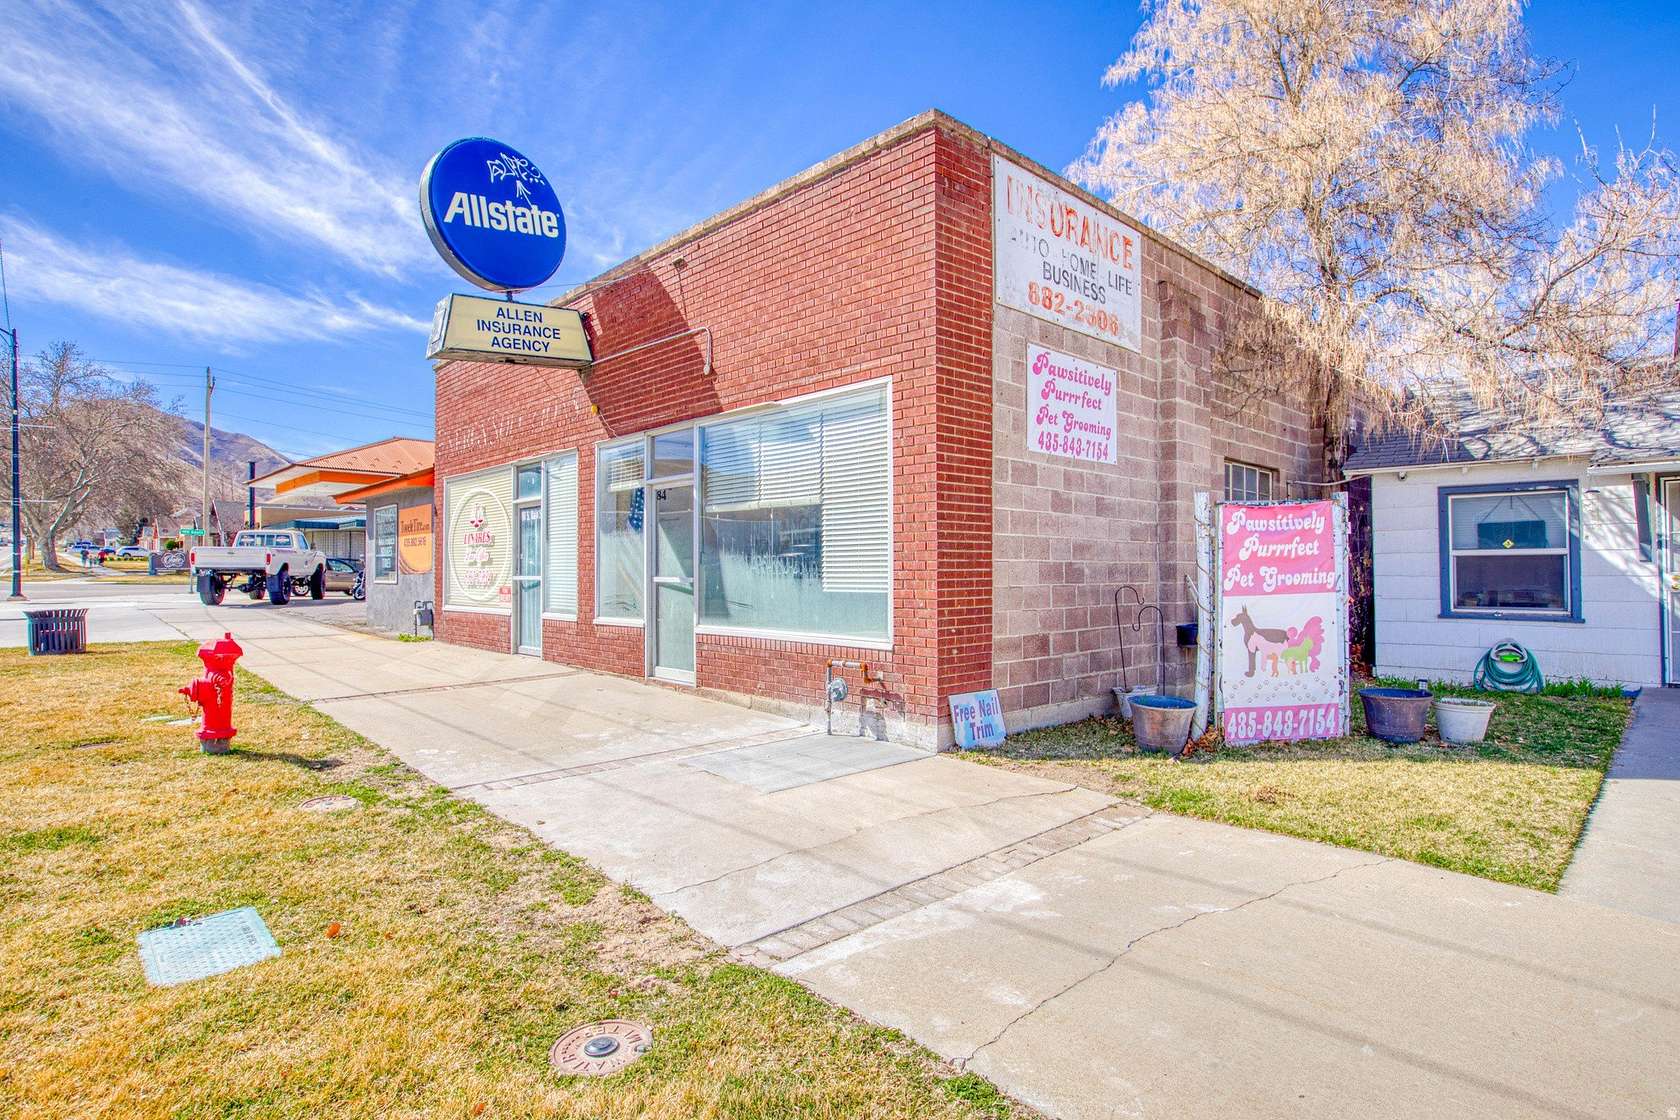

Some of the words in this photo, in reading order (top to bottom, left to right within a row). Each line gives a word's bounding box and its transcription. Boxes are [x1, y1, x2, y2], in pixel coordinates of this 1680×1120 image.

[444, 191, 559, 238] Allstate
[1007, 175, 1134, 270] INSURANCE
[1042, 260, 1106, 304] BUSINESS
[1108, 270, 1133, 297] LIFE
[477, 319, 561, 339] INSURANCE
[496, 307, 542, 323] ALLEN
[491, 336, 550, 352] AGENCY
[1032, 351, 1112, 396] Pawsitively
[1041, 377, 1102, 410] Purrrfect
[1036, 403, 1058, 425] Pet
[1062, 410, 1111, 440] Grooming
[1038, 430, 1108, 460] 435-843-7154
[656, 489, 666, 500] 84
[1226, 508, 1325, 535] Pawsitively
[1238, 532, 1320, 561] Purrrfect
[1223, 564, 1254, 591] Pet
[1259, 566, 1336, 593] Grooming
[953, 704, 976, 724] Free
[978, 696, 999, 718] Nail
[1227, 708, 1336, 740] 435-843-7154
[969, 720, 995, 741] Trim
